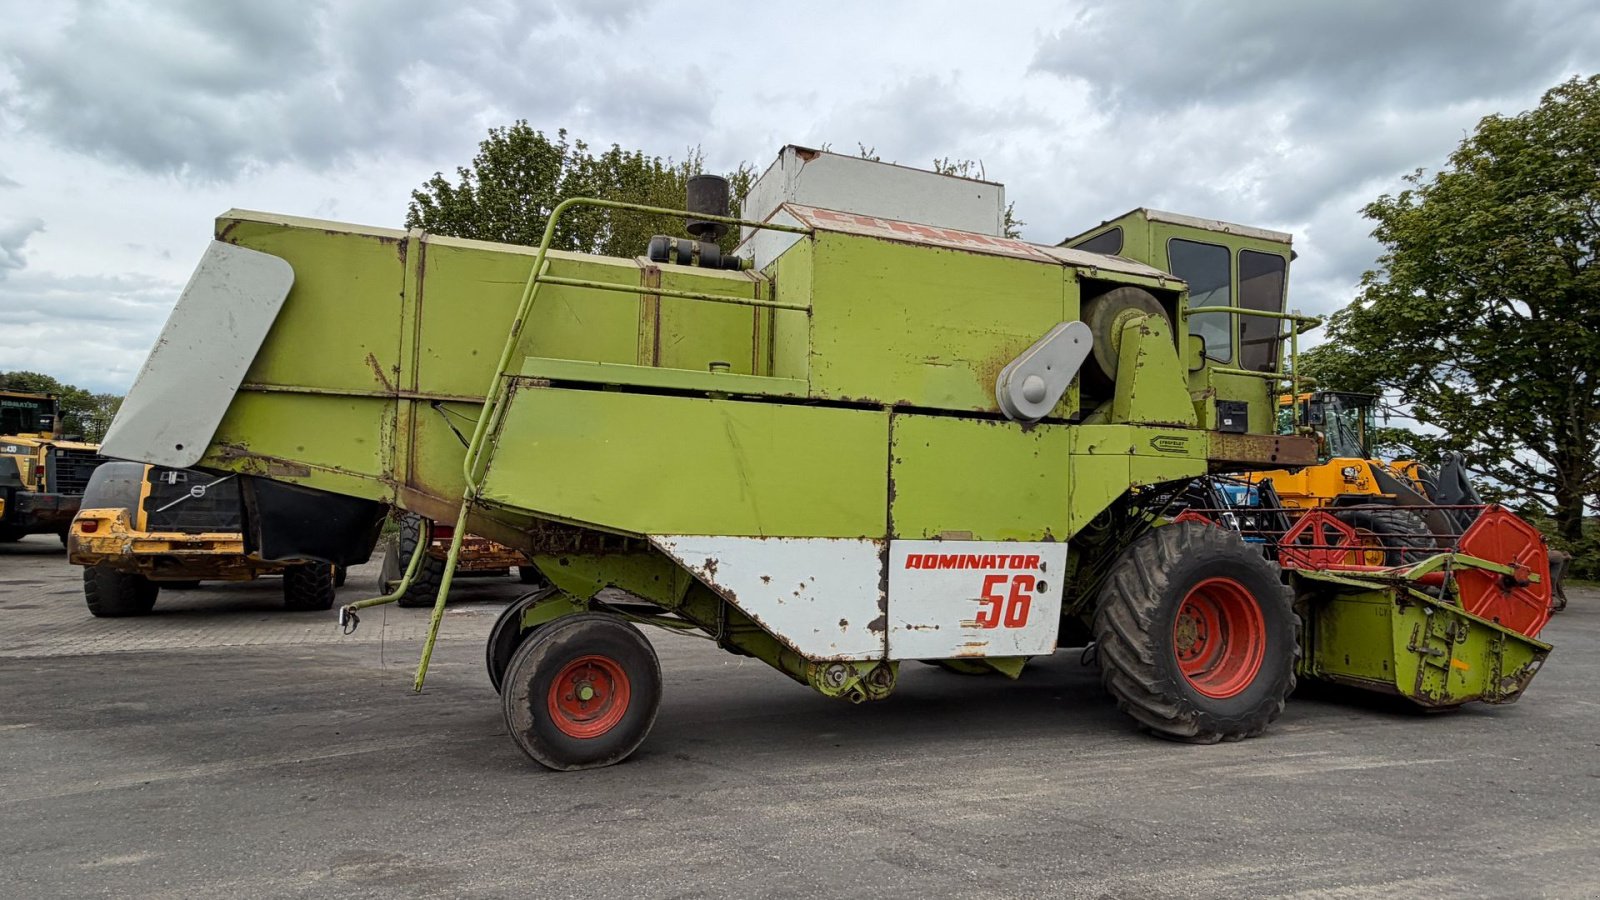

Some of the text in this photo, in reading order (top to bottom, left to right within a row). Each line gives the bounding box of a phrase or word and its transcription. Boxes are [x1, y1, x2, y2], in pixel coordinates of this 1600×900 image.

[1, 400, 38, 408] KOMATSU
[905, 554, 1040, 570] DOMINATOR
[975, 574, 1036, 629] 56
